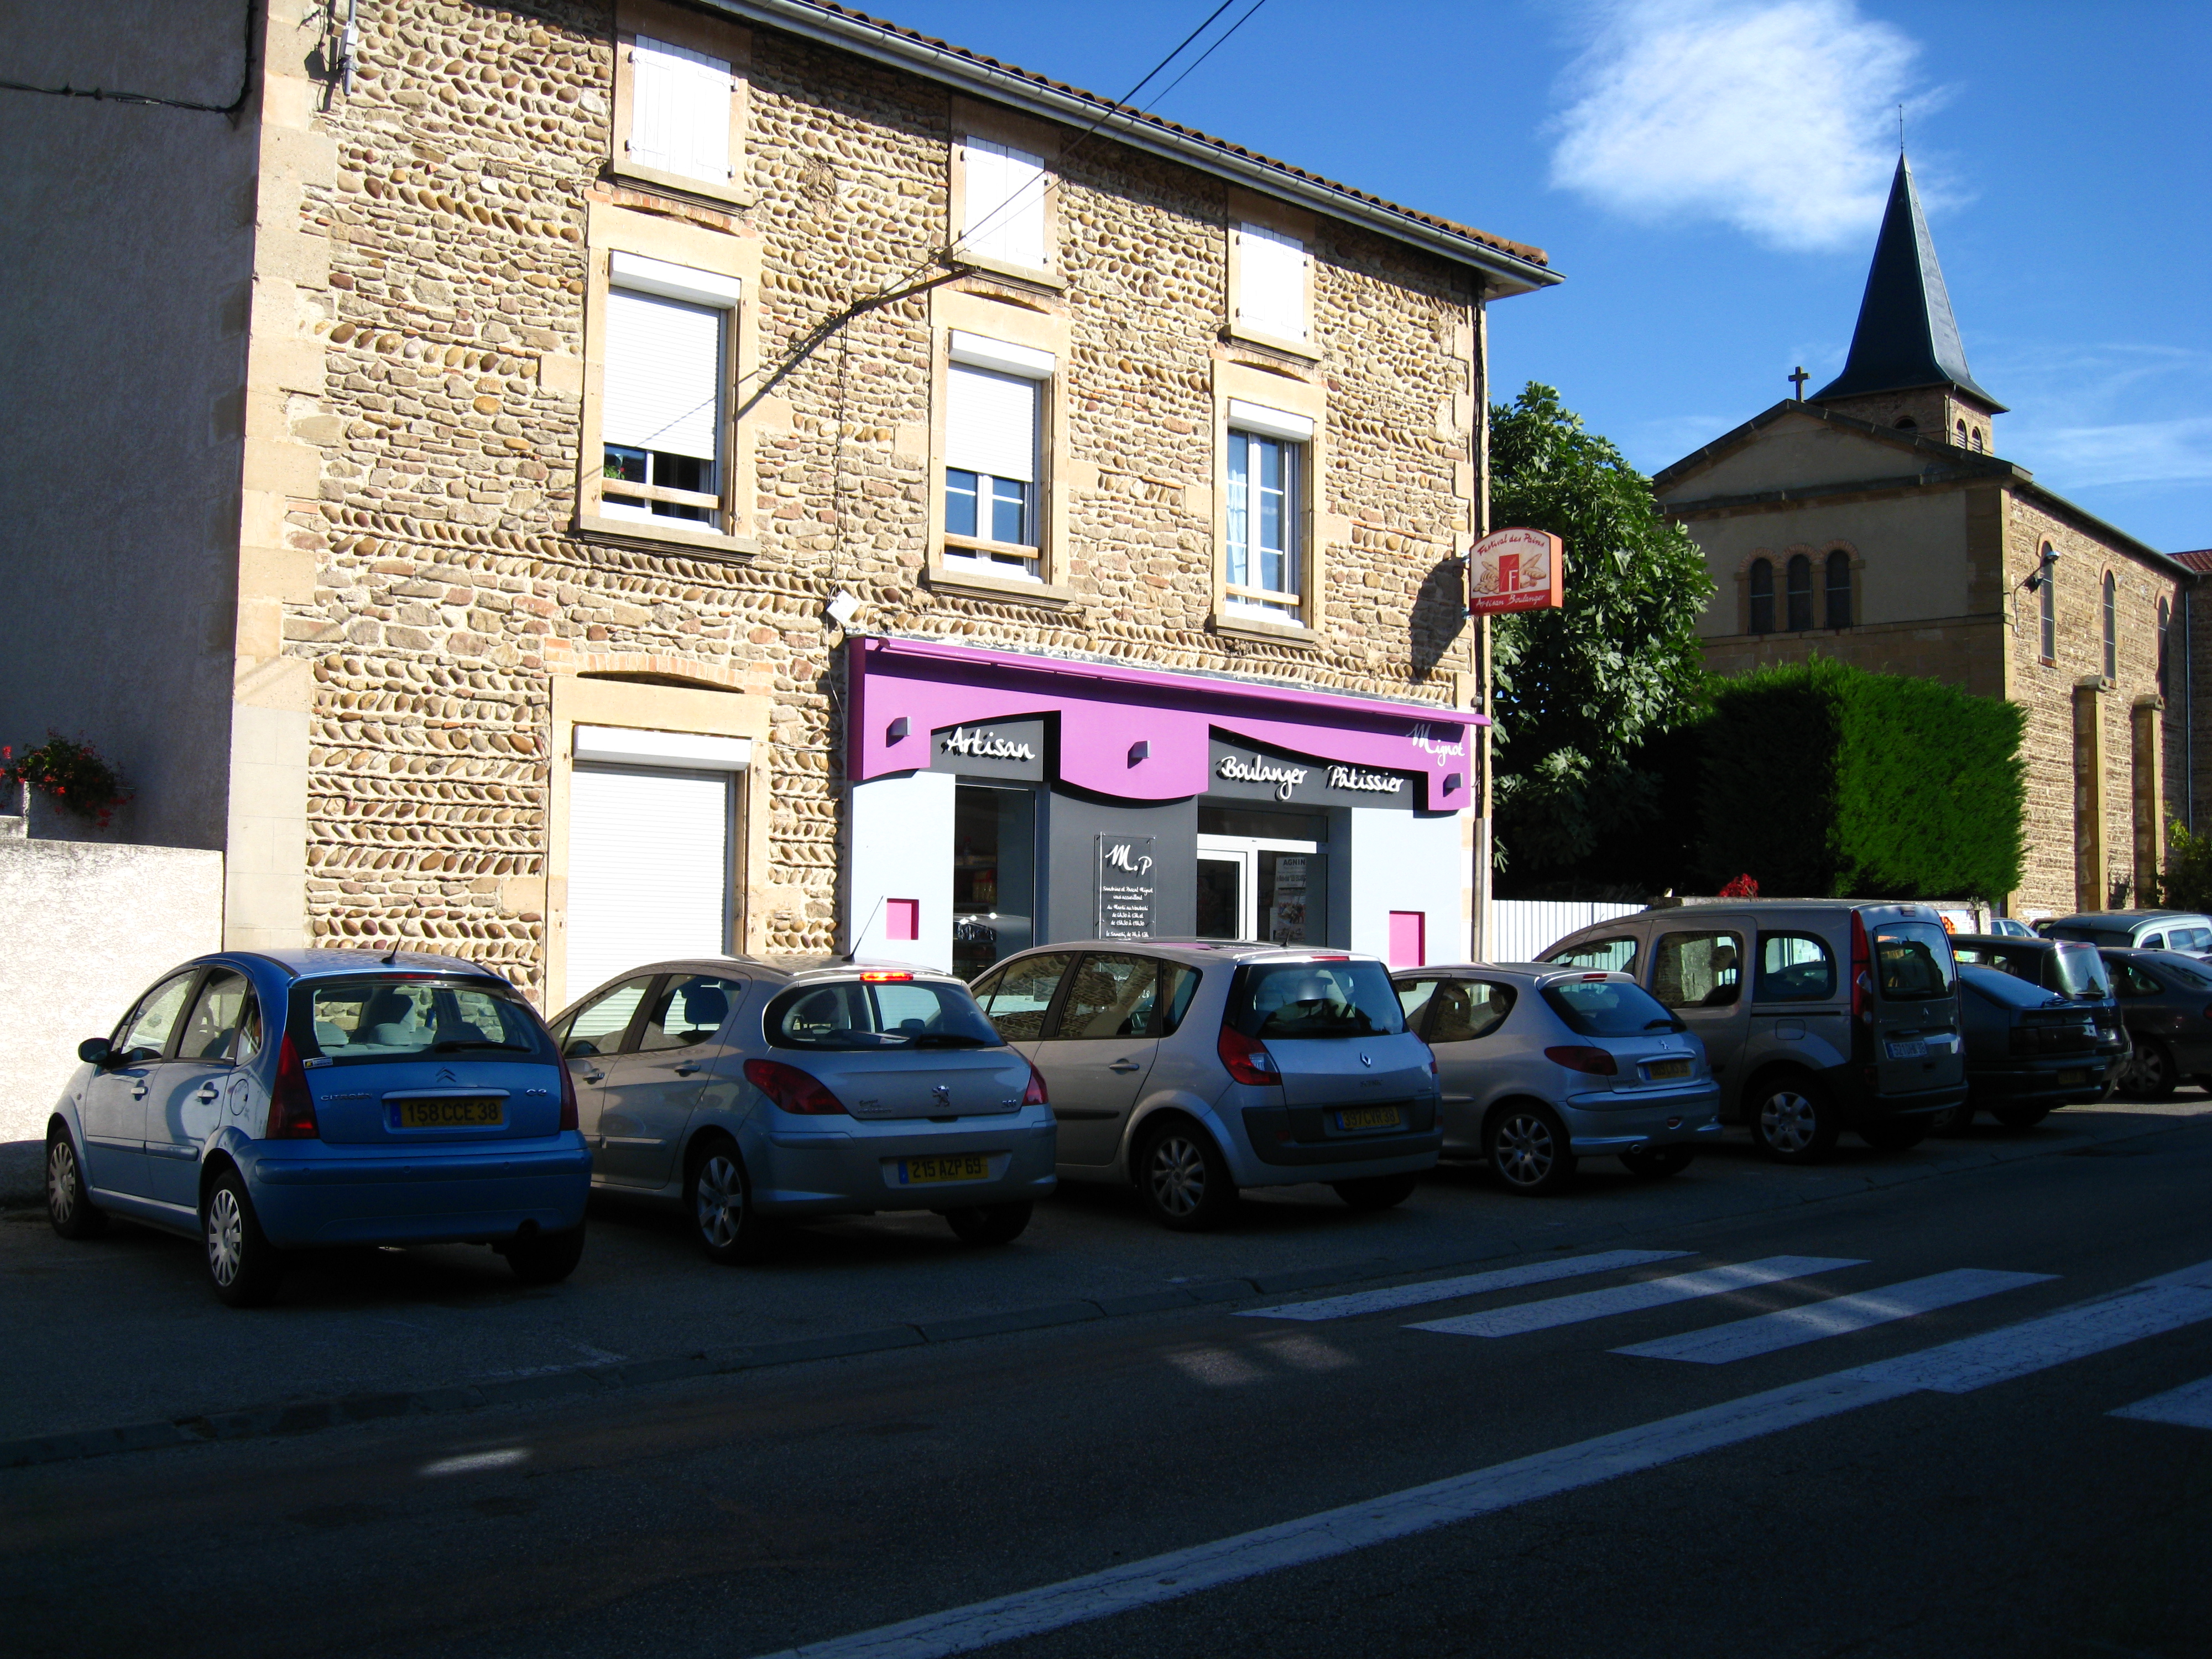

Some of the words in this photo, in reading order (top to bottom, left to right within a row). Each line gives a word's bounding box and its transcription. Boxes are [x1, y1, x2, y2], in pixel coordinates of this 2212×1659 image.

[1477, 534, 1508, 556] Festival
[1509, 534, 1521, 543] des
[1524, 533, 1545, 547] Pains
[1476, 598, 1504, 608] Artisan
[1507, 593, 1546, 606] Boulanger
[946, 726, 1036, 760] Artisan
[1405, 723, 1465, 767] Mignot
[1220, 754, 1308, 800] Boulanger
[1327, 765, 1404, 792] Pâtissier
[1140, 887, 1154, 896] Mignot
[320, 1092, 373, 1102] CITROËN
[408, 1103, 440, 1122] 158
[441, 1103, 474, 1121] CCE
[477, 1102, 499, 1120] 38
[1343, 1110, 1362, 1126] 397
[1363, 1109, 1383, 1125] CVR
[1382, 1108, 1396, 1123] 38
[912, 1160, 936, 1178] 215
[939, 1159, 962, 1176] AZP
[965, 1157, 982, 1174] 69
